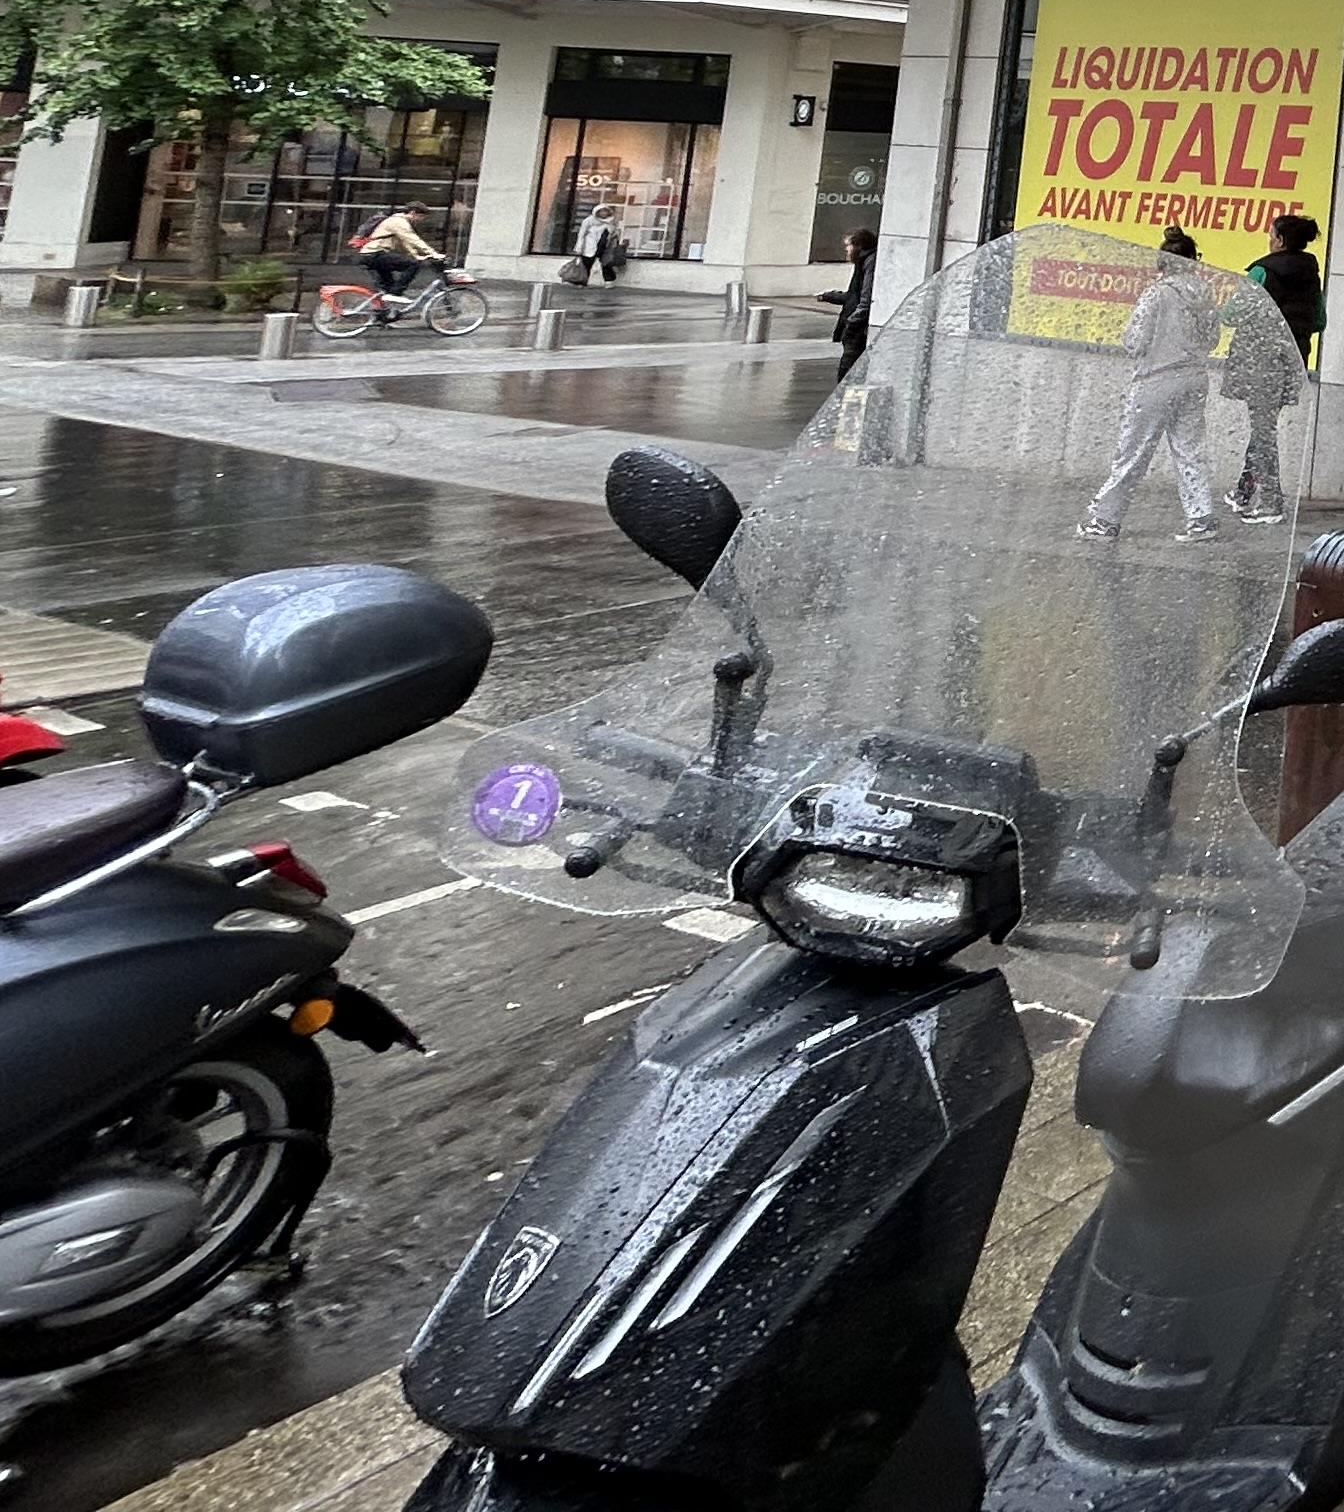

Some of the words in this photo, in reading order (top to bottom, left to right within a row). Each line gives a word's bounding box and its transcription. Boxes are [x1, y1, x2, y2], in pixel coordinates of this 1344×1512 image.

[1051, 46, 1319, 95] LIQUIDATION
[1043, 99, 1313, 190] TOTALE
[817, 193, 883, 205] BOUCHA
[1037, 187, 1133, 223] AVANT
[511, 780, 533, 809] 1
